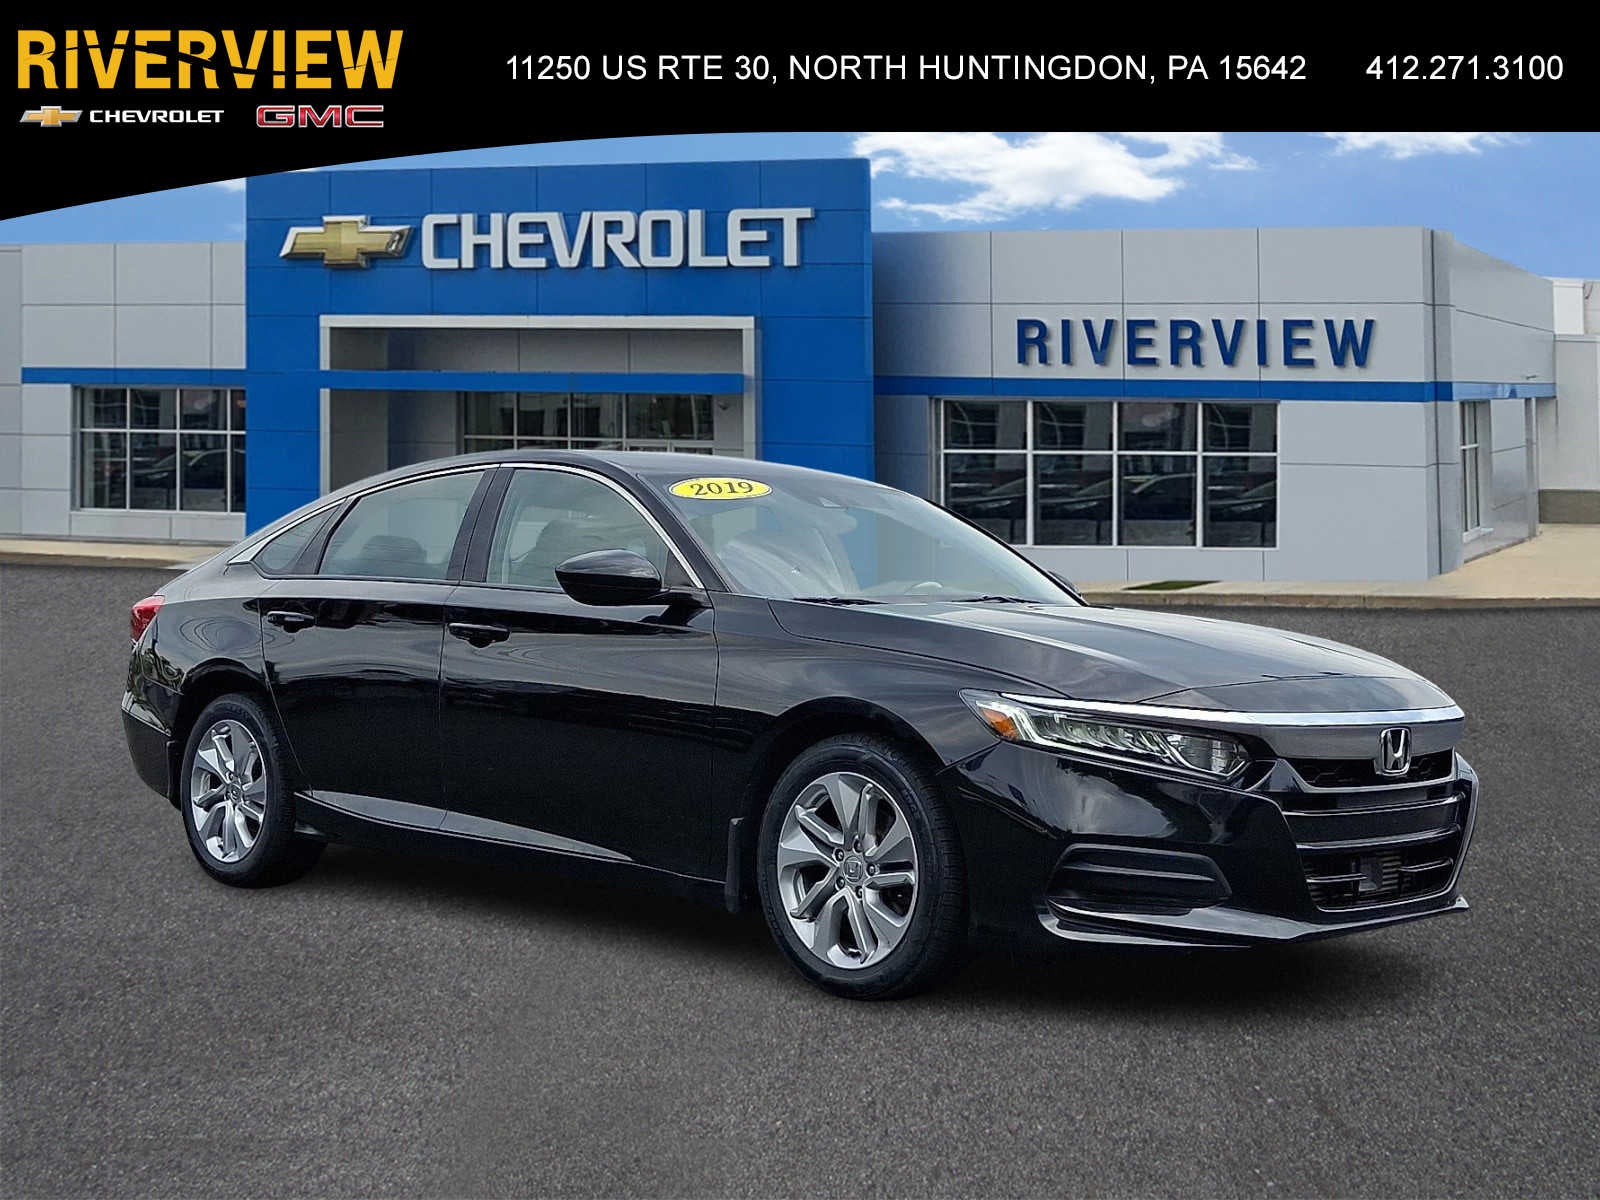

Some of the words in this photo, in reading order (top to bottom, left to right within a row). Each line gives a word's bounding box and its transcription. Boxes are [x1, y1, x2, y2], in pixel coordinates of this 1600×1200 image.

[421, 207, 815, 270] CHEVROLET
[1016, 318, 1376, 368] RIVERVIEW
[690, 481, 753, 496] 2019
